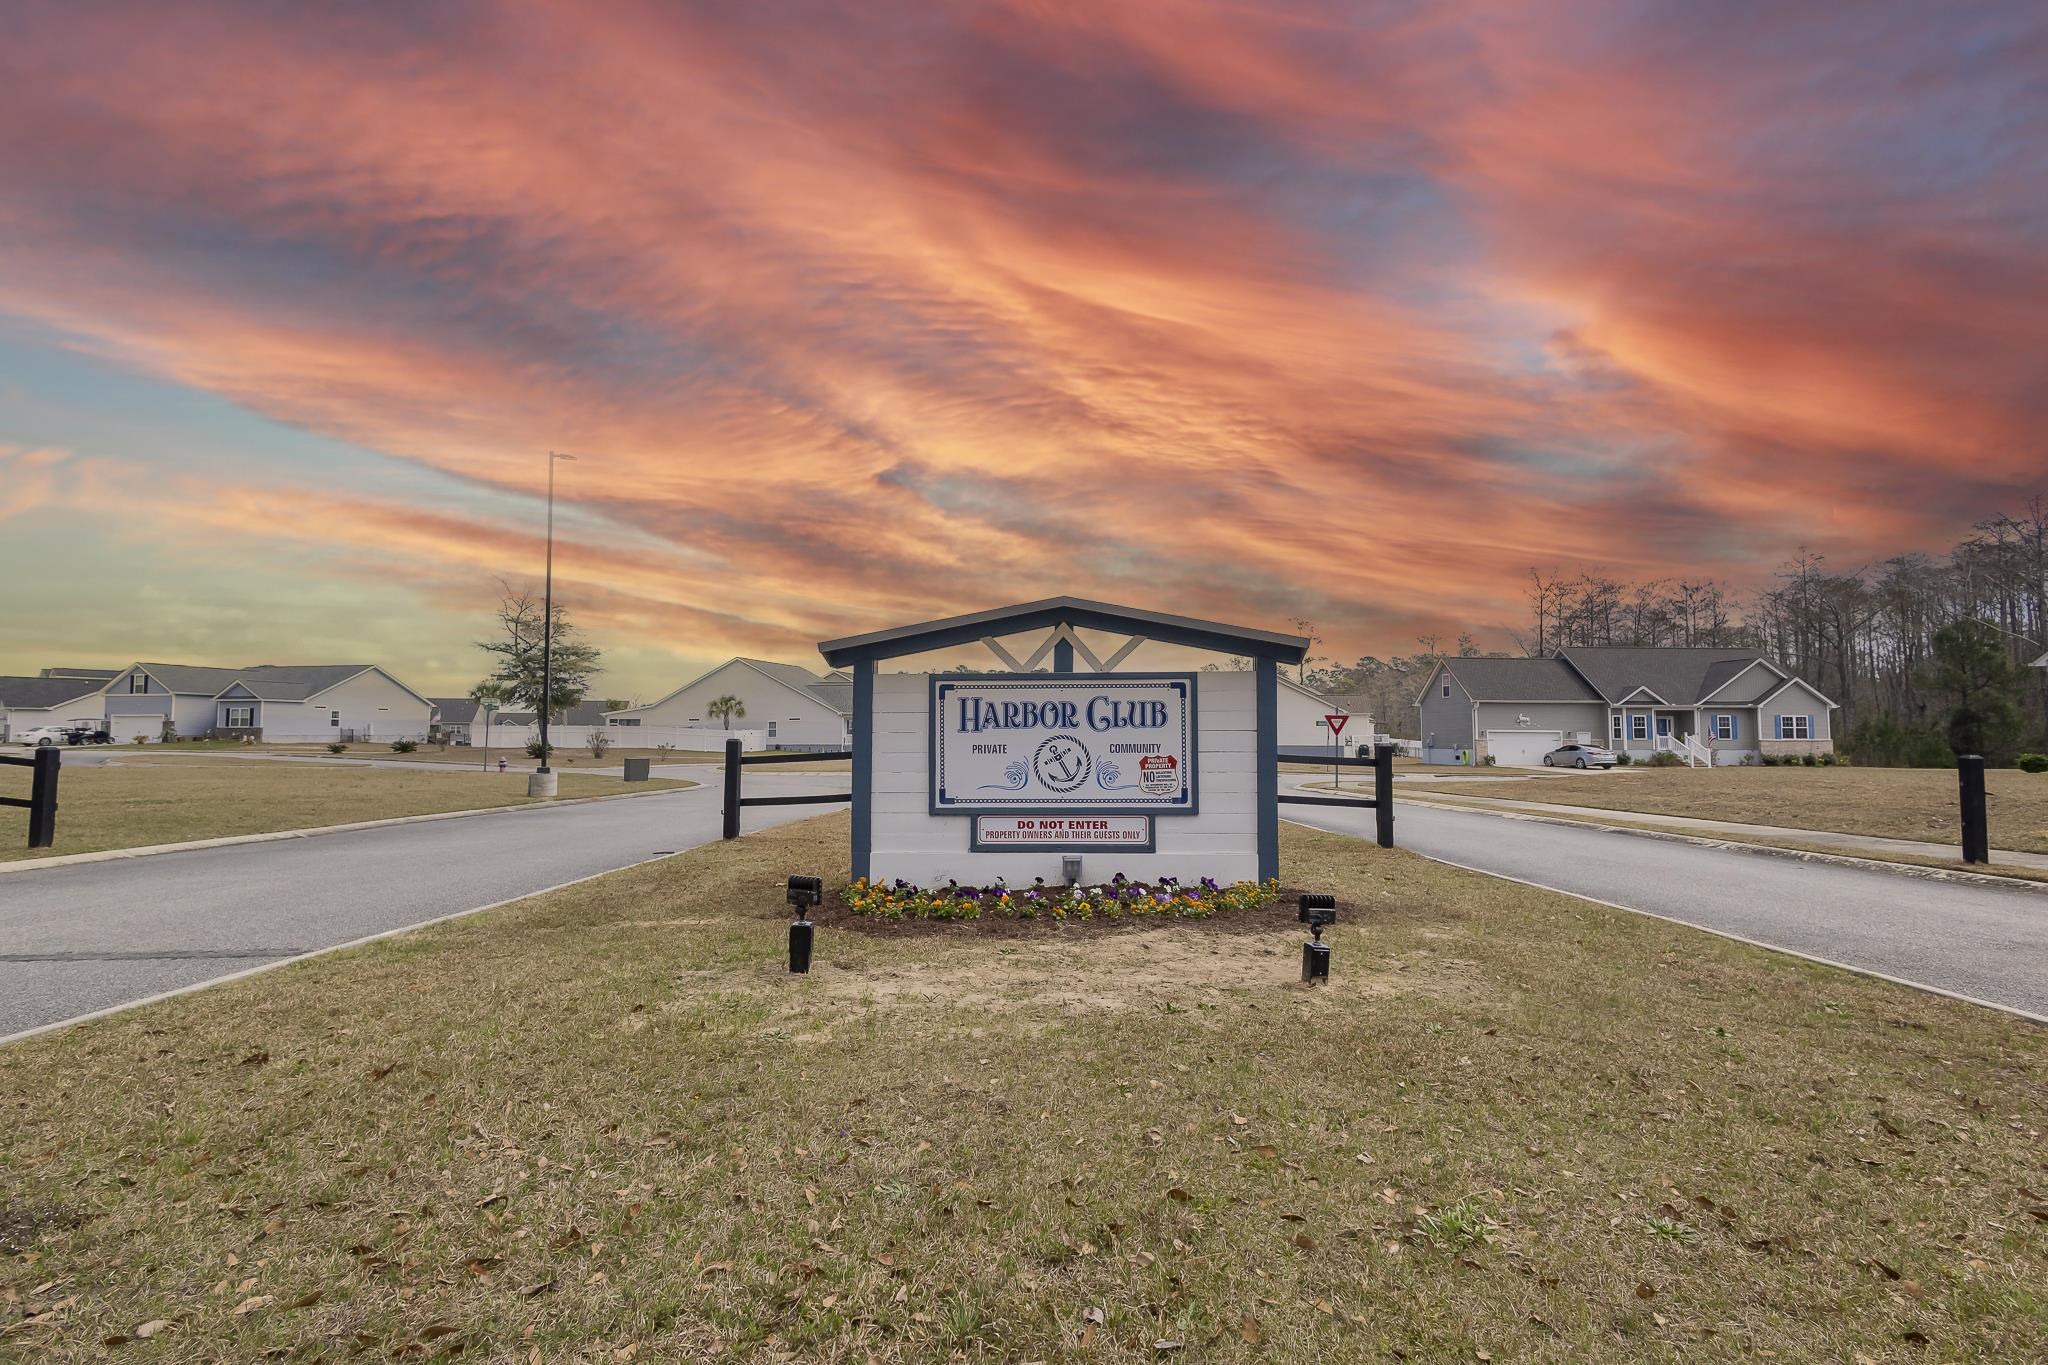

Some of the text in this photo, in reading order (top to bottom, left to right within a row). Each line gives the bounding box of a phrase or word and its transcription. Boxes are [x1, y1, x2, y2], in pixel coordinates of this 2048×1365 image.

[957, 695, 1168, 733] HARBOR CLUB
[972, 743, 1162, 755] PRIVATE COMMUNITY
[1143, 771, 1155, 782] NO
[1017, 820, 1108, 829] DO NOT ENTER
[985, 831, 1141, 839] PROPERTY OWNERS AND THEIR GUESTS ONLY
